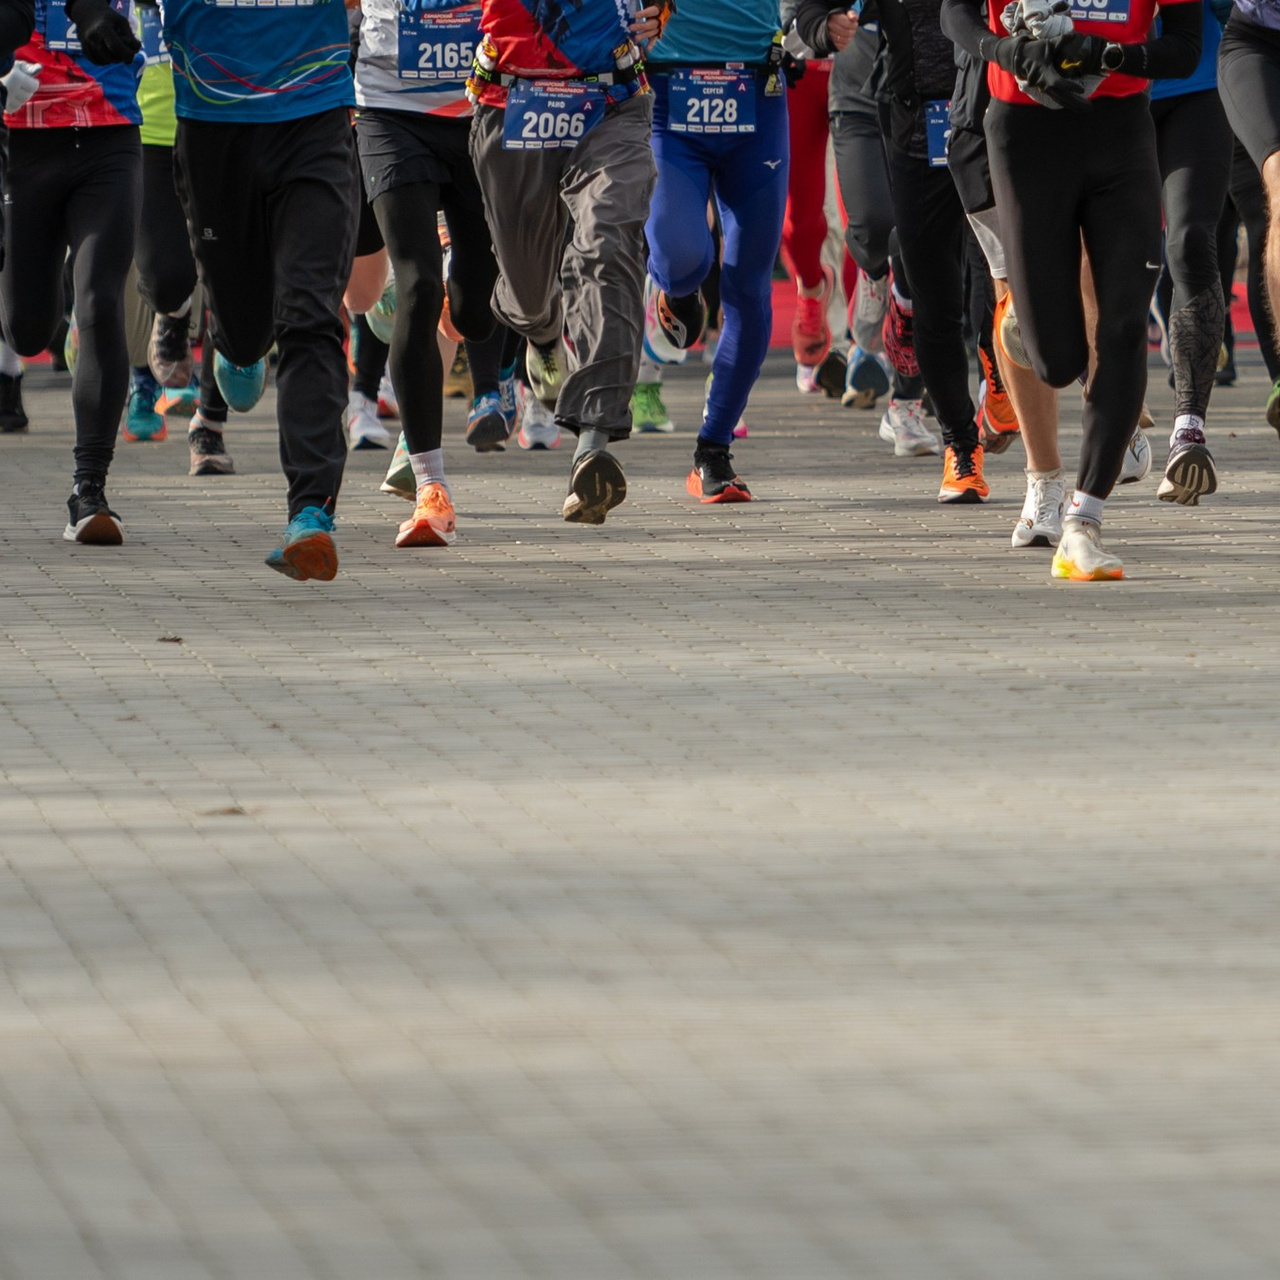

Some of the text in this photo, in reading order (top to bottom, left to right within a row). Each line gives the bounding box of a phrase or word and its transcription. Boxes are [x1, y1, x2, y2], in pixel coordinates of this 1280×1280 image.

[418, 41, 473, 69] 2165
[702, 86, 724, 95] СЕРГЕЙ
[686, 98, 738, 123] 2128
[521, 110, 586, 139] 2066
